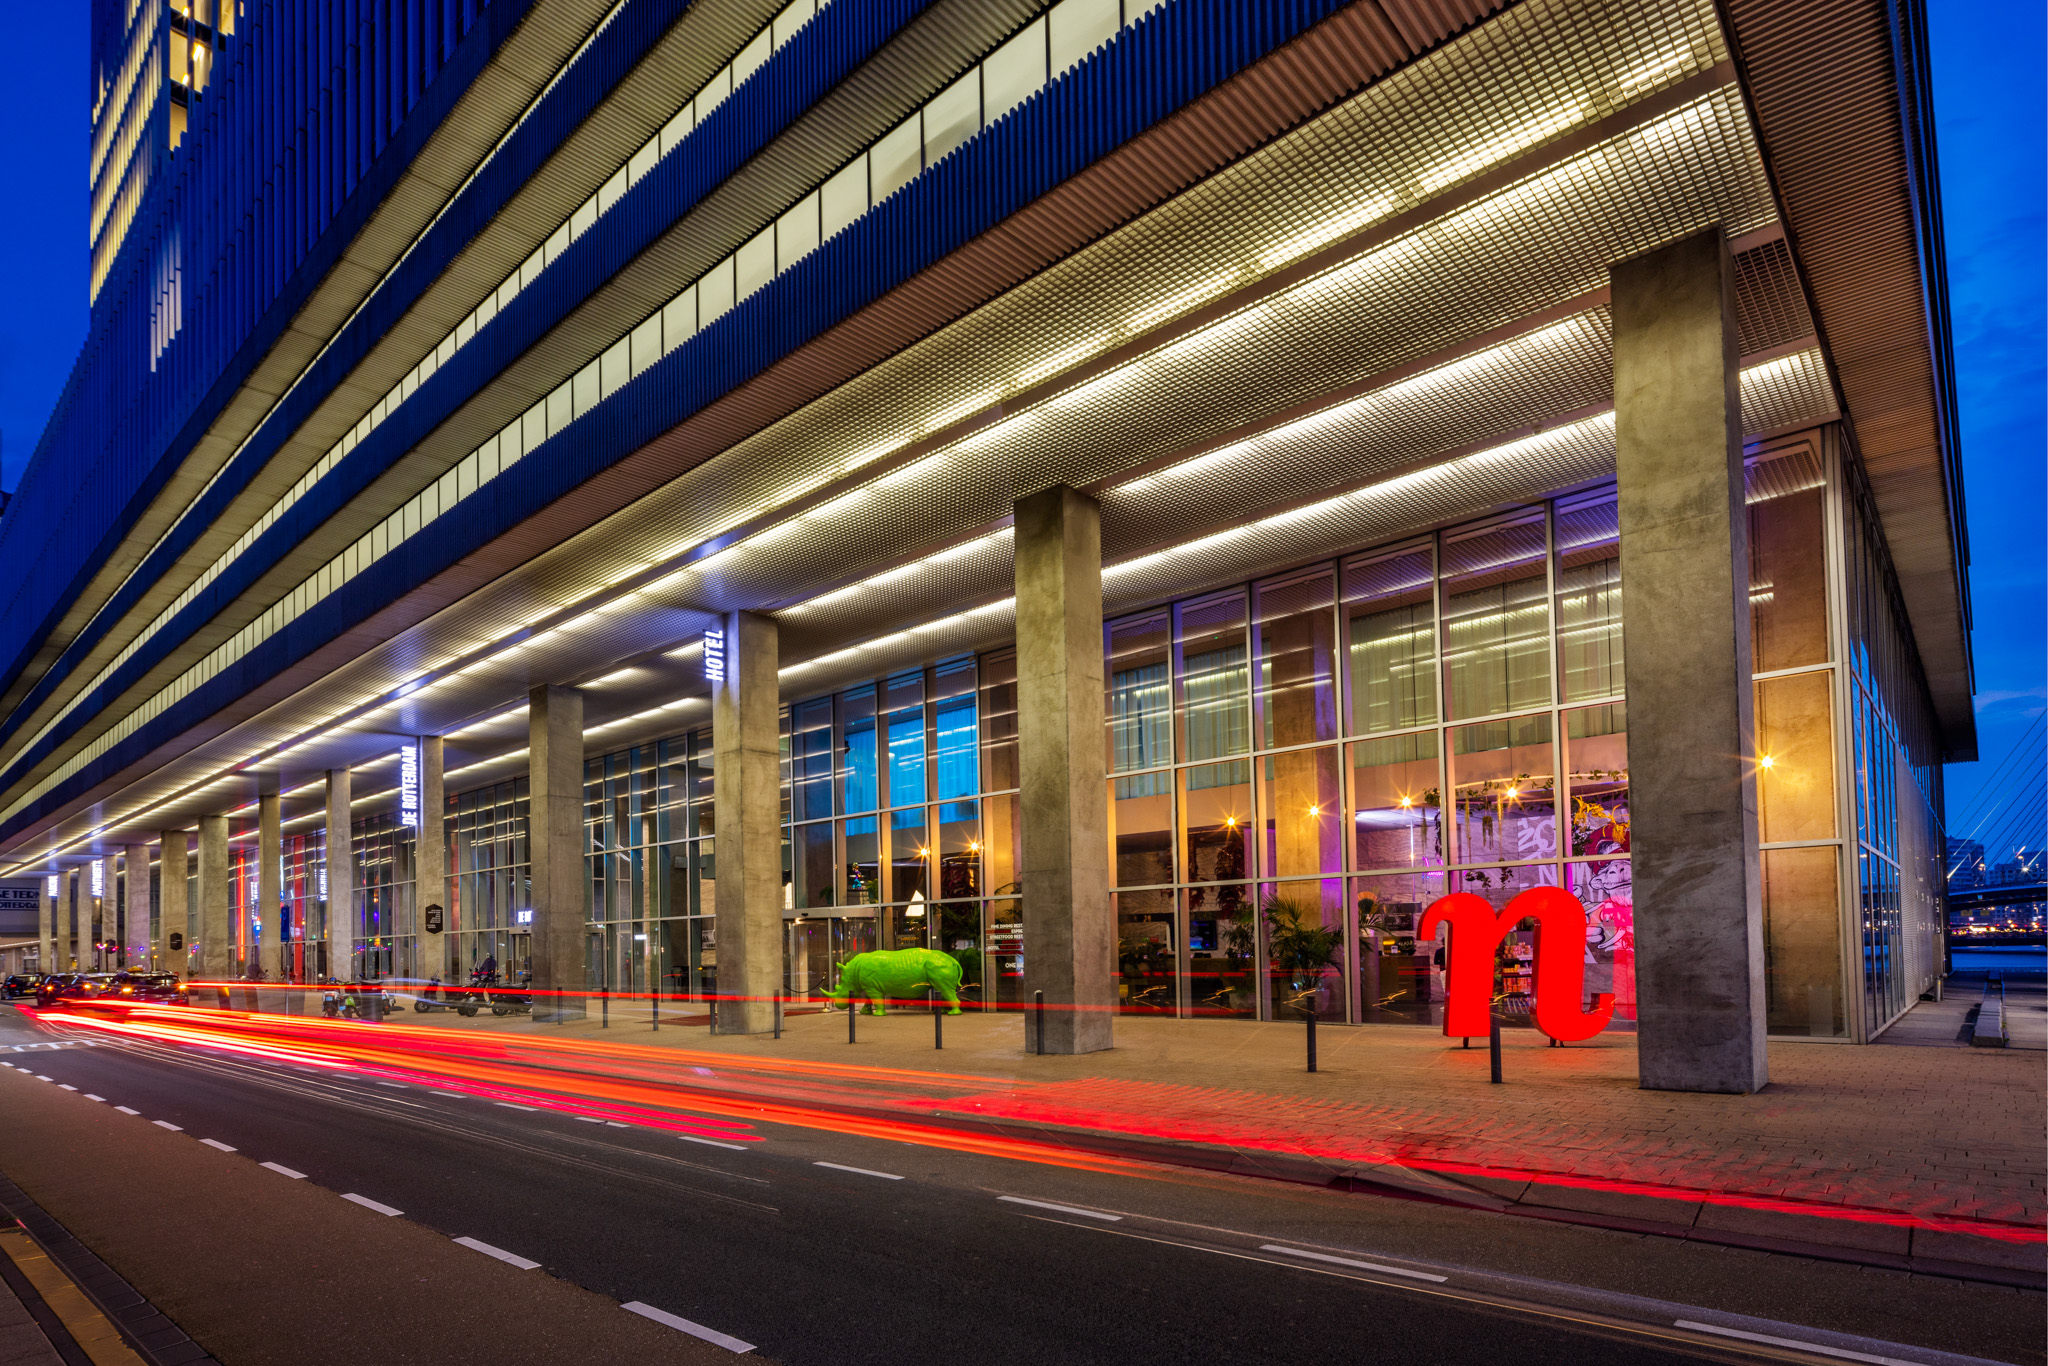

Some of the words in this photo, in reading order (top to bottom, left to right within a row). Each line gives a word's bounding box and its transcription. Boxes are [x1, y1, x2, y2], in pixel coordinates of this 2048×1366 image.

[706, 631, 723, 681] HOTEL
[401, 746, 417, 810] ROTTERDAM
[402, 811, 418, 826] DE
